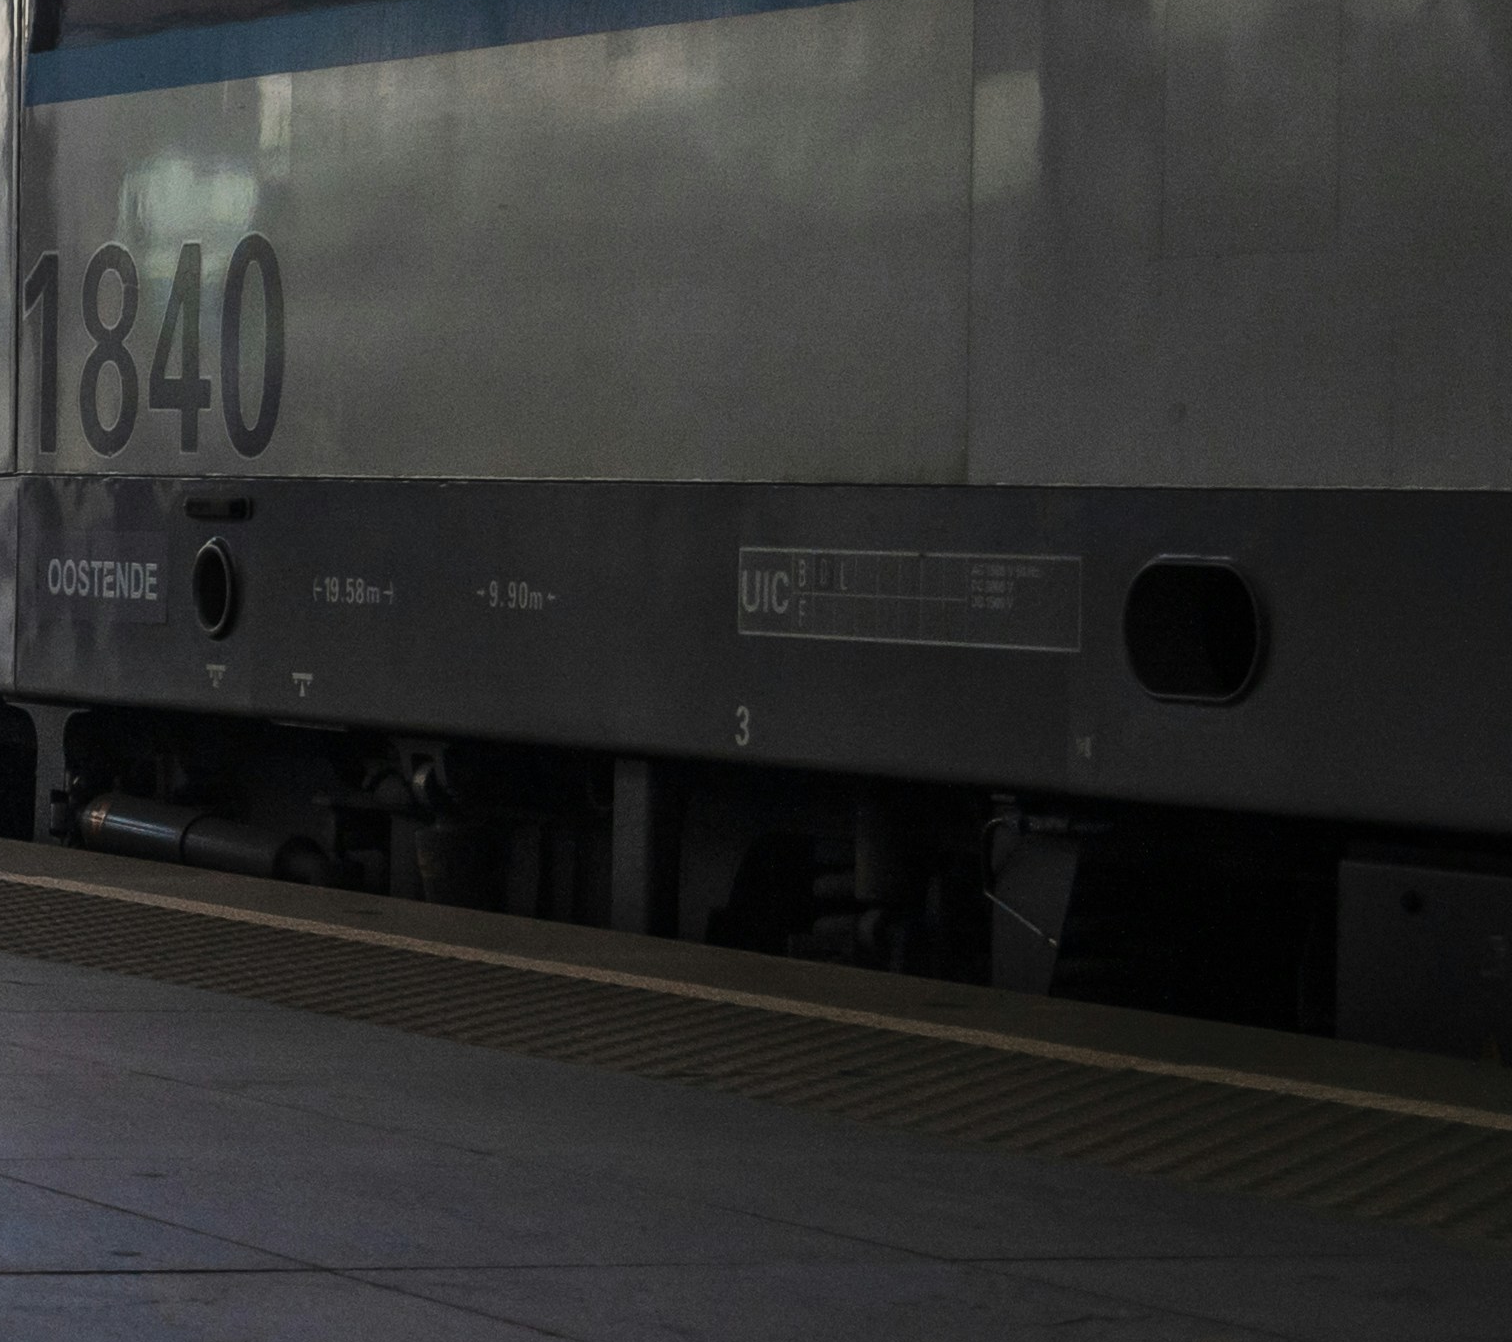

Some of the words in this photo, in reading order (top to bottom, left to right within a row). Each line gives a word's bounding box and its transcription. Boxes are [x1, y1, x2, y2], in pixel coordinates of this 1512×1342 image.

[22, 231, 286, 459] 1840
[47, 557, 158, 601] OOSTENDE
[323, 576, 380, 604] 19.58m
[488, 579, 544, 611] 9.90m
[741, 570, 789, 615] UIC
[734, 705, 750, 747] 3
